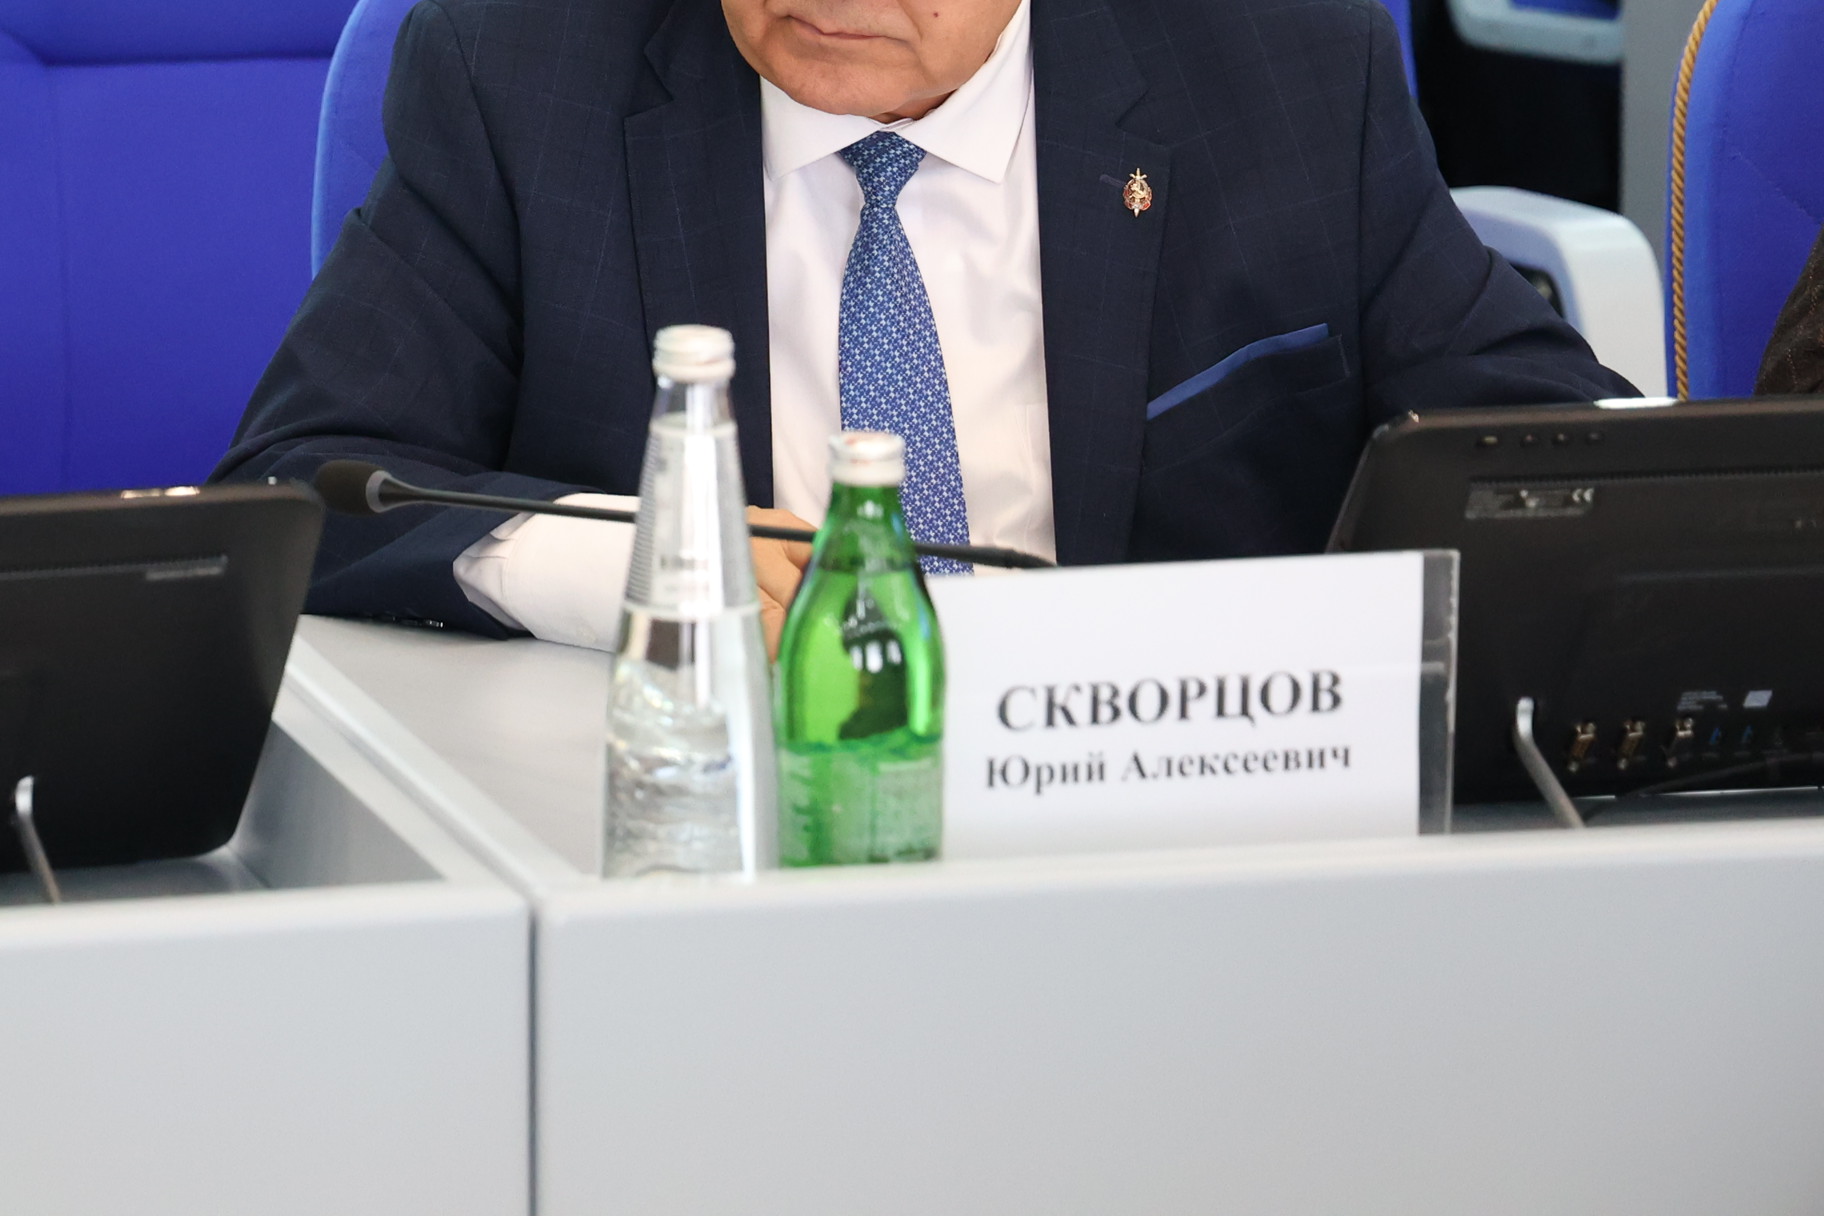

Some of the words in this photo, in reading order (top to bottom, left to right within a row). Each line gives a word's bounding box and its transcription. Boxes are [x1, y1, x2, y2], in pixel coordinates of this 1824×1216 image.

[996, 670, 1343, 731] СКВОРЦОВ
[986, 751, 1106, 796] Юрий
[1122, 745, 1351, 782] Алексеевич
